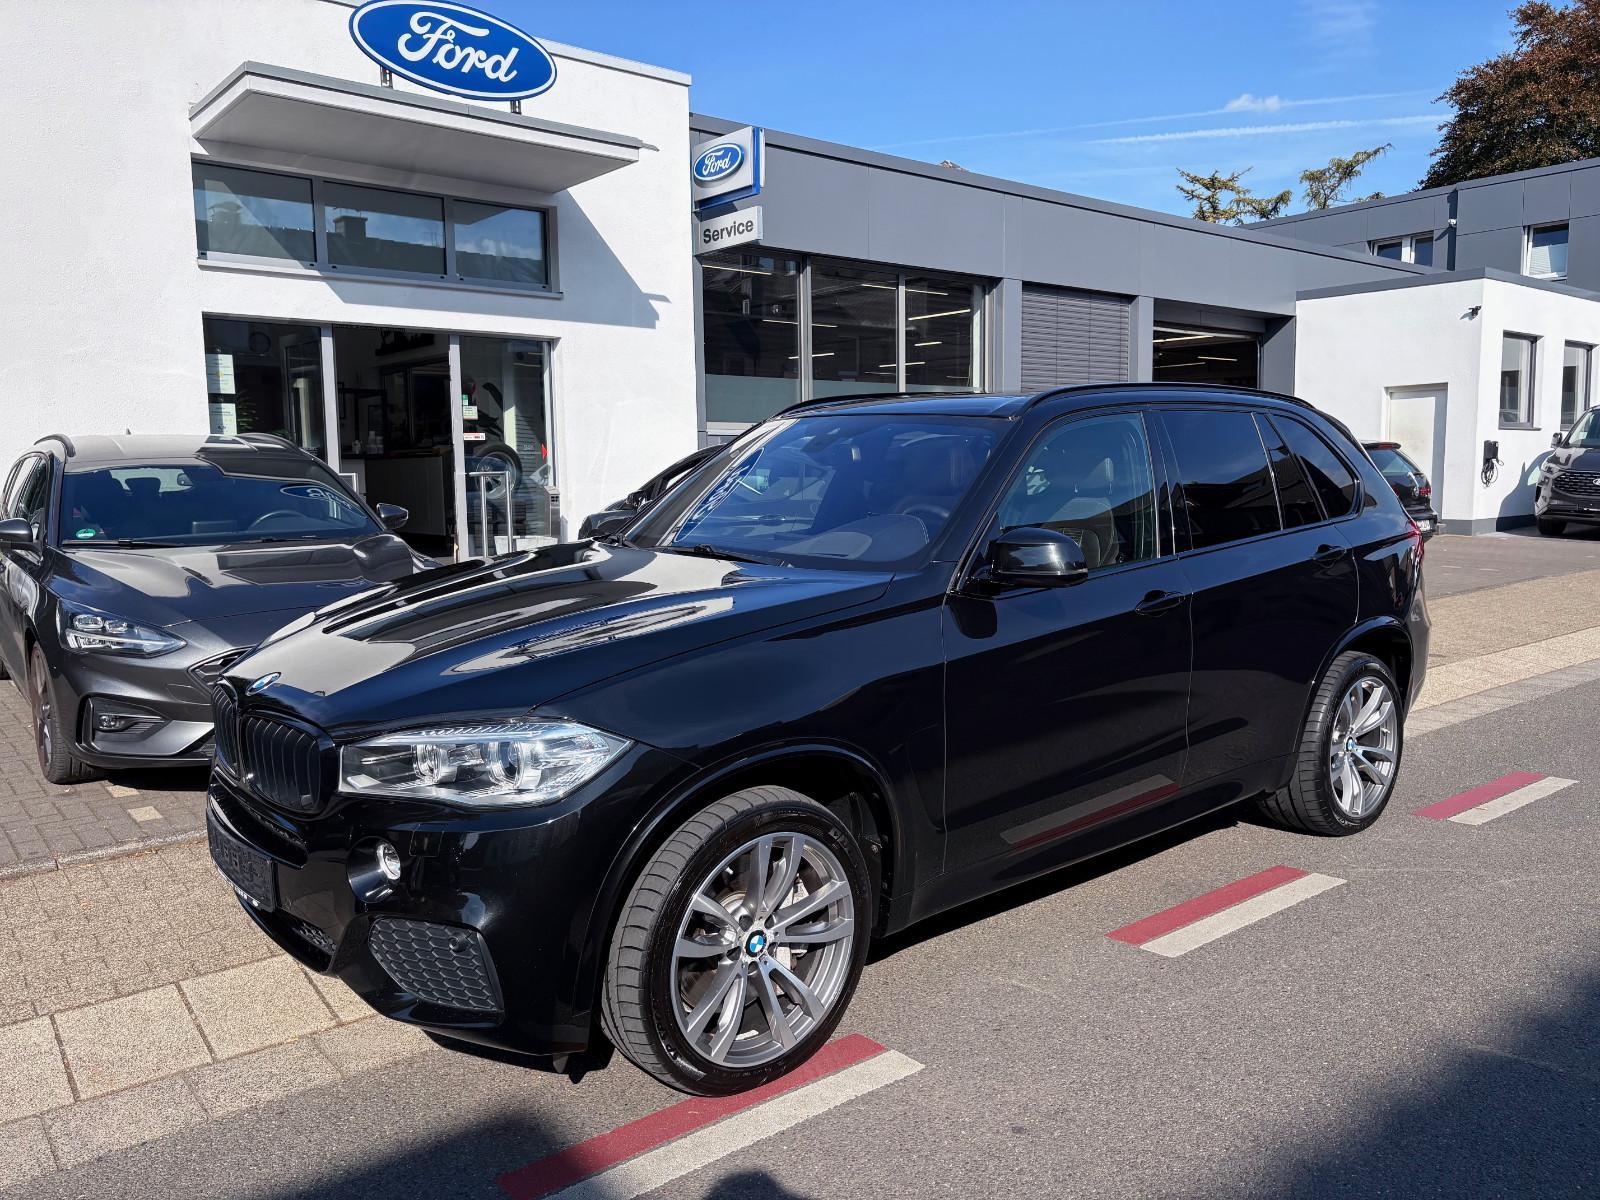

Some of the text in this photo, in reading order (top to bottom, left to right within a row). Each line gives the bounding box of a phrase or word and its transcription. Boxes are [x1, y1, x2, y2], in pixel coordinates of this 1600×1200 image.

[397, 11, 520, 83] Ford
[702, 149, 732, 176] Ford
[703, 219, 754, 244] Service
